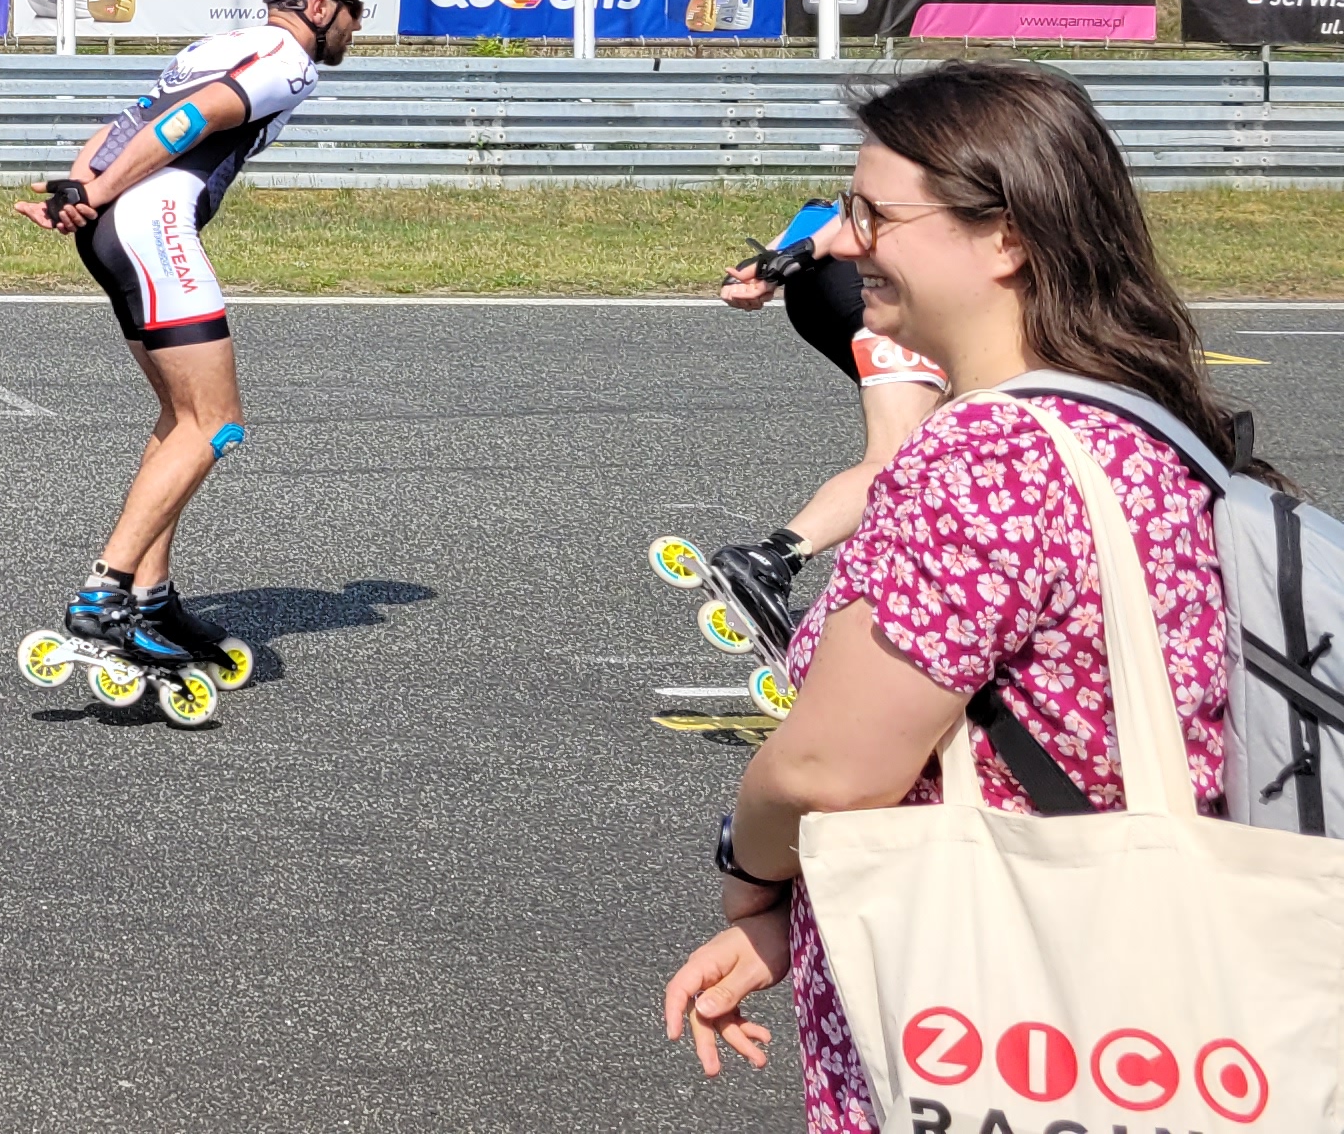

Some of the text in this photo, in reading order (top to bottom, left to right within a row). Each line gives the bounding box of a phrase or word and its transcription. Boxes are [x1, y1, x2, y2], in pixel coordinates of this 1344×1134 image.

[1020, 15, 1125, 28] www.qarmax.pl
[161, 199, 199, 294] ROLLTEAM
[903, 1006, 1269, 1124] ZICO
